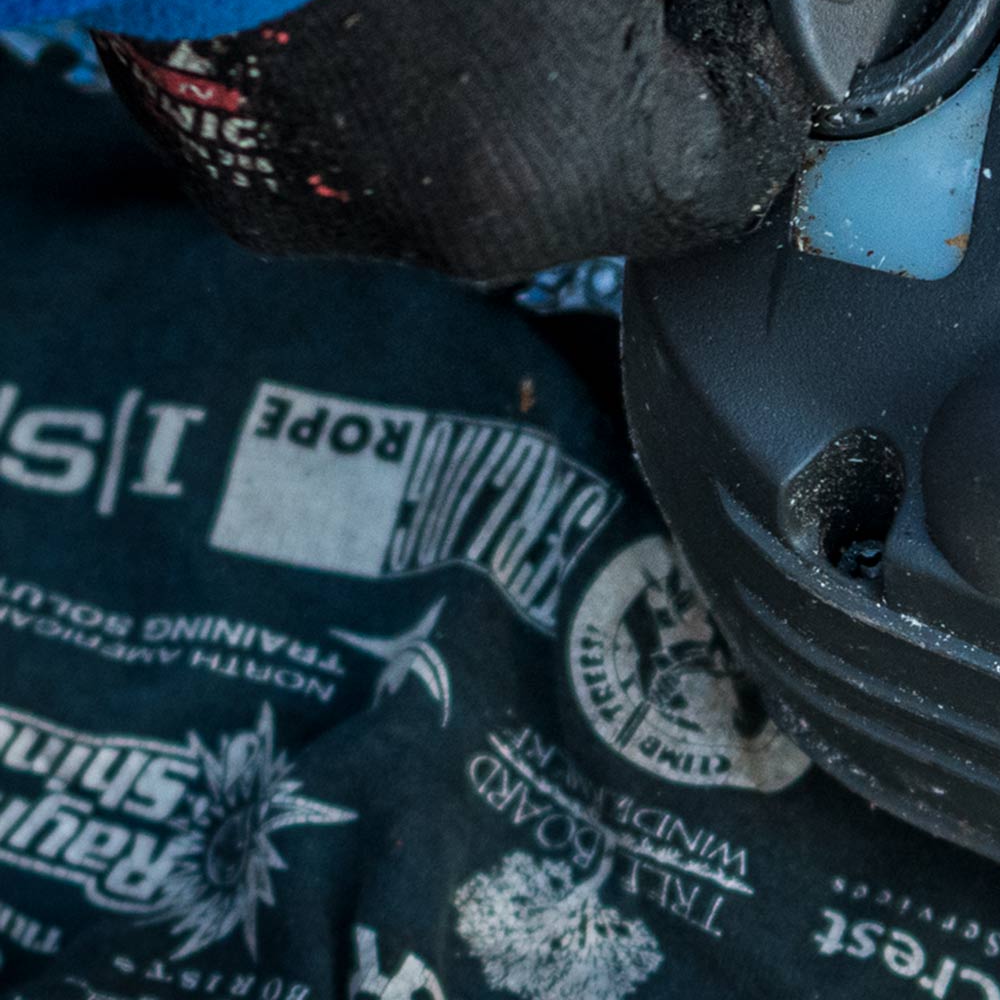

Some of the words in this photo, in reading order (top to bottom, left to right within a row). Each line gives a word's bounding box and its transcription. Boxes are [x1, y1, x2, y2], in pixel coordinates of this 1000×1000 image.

[254, 394, 414, 464] ROPE
[141, 614, 346, 676] TRAINING
[190, 649, 337, 703] NORTH
[640, 735, 732, 776] CLIMB
[469, 754, 602, 869] BOARD
